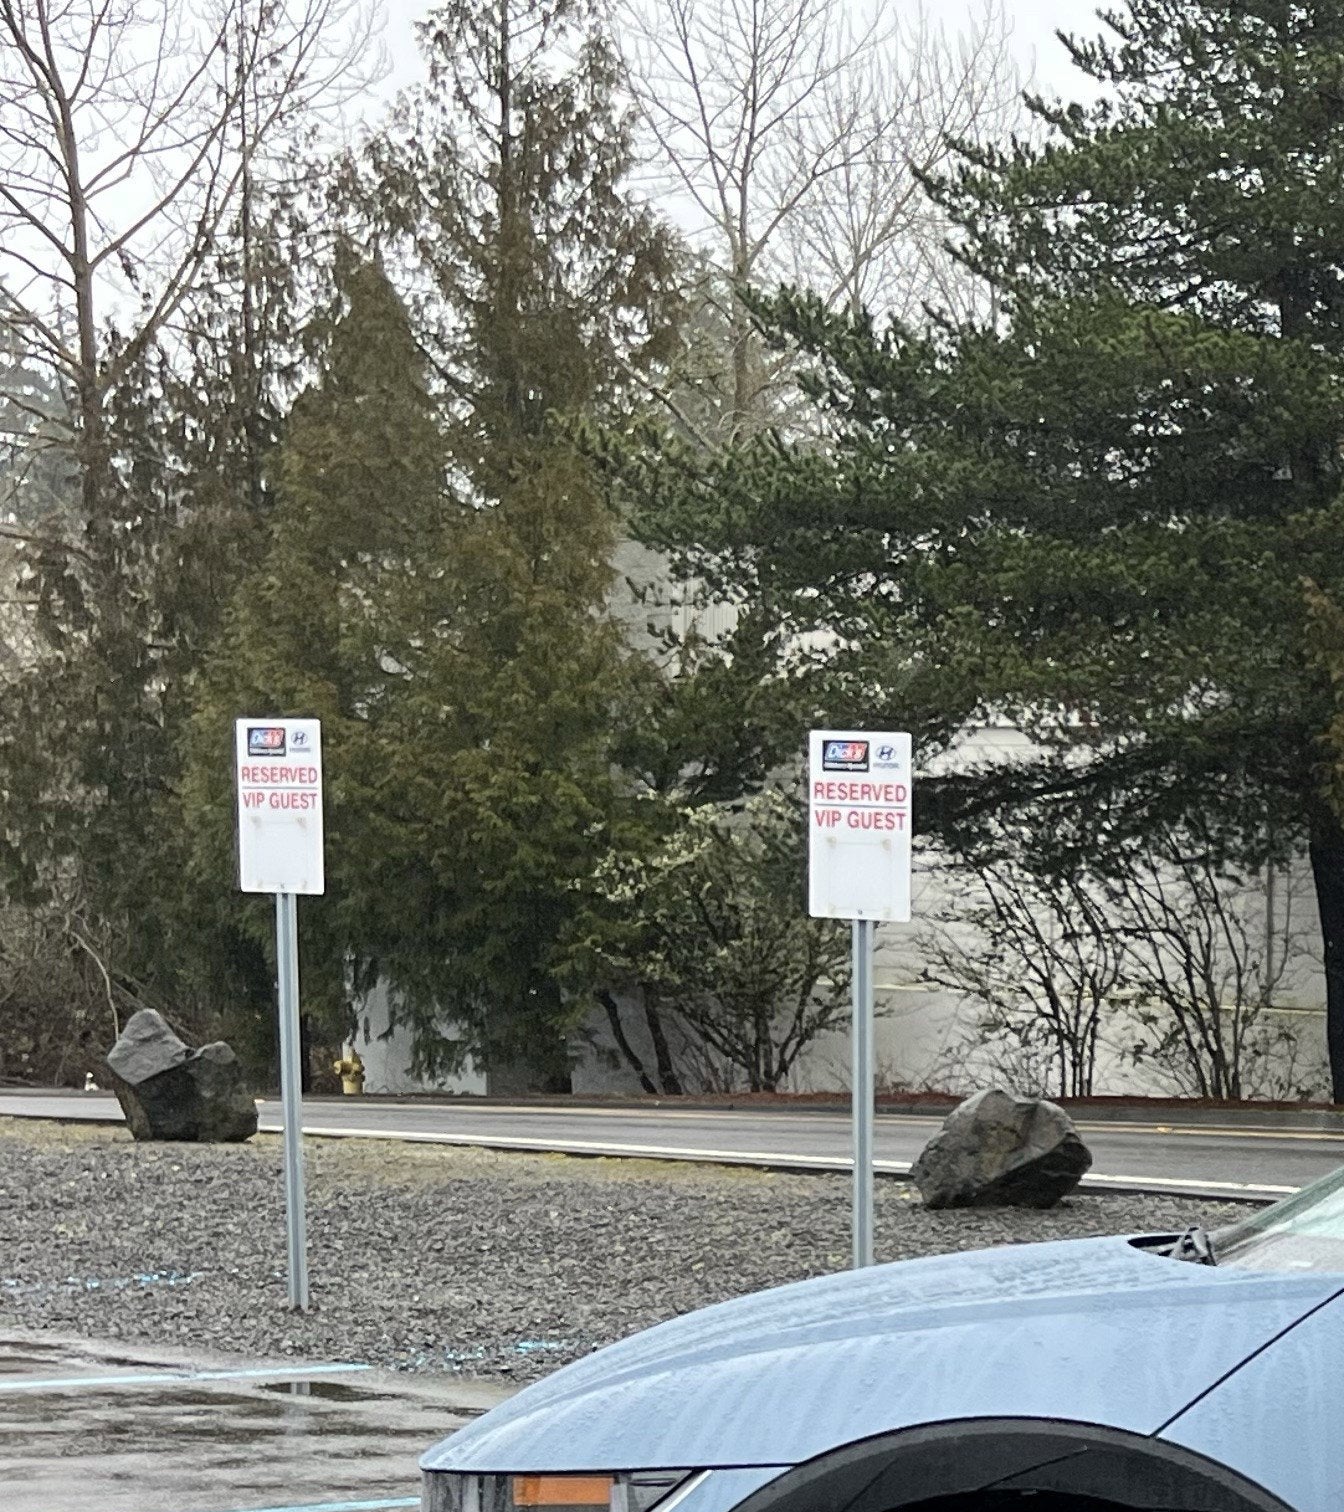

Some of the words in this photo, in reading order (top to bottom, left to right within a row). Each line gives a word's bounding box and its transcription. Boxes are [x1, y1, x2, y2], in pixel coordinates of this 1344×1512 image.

[241, 766, 318, 783] RESERVED
[242, 792, 265, 808] VIP
[269, 792, 317, 809] GUEST
[814, 782, 907, 803] RESERVED
[815, 810, 842, 828] VIP
[847, 811, 907, 830] GUEST
